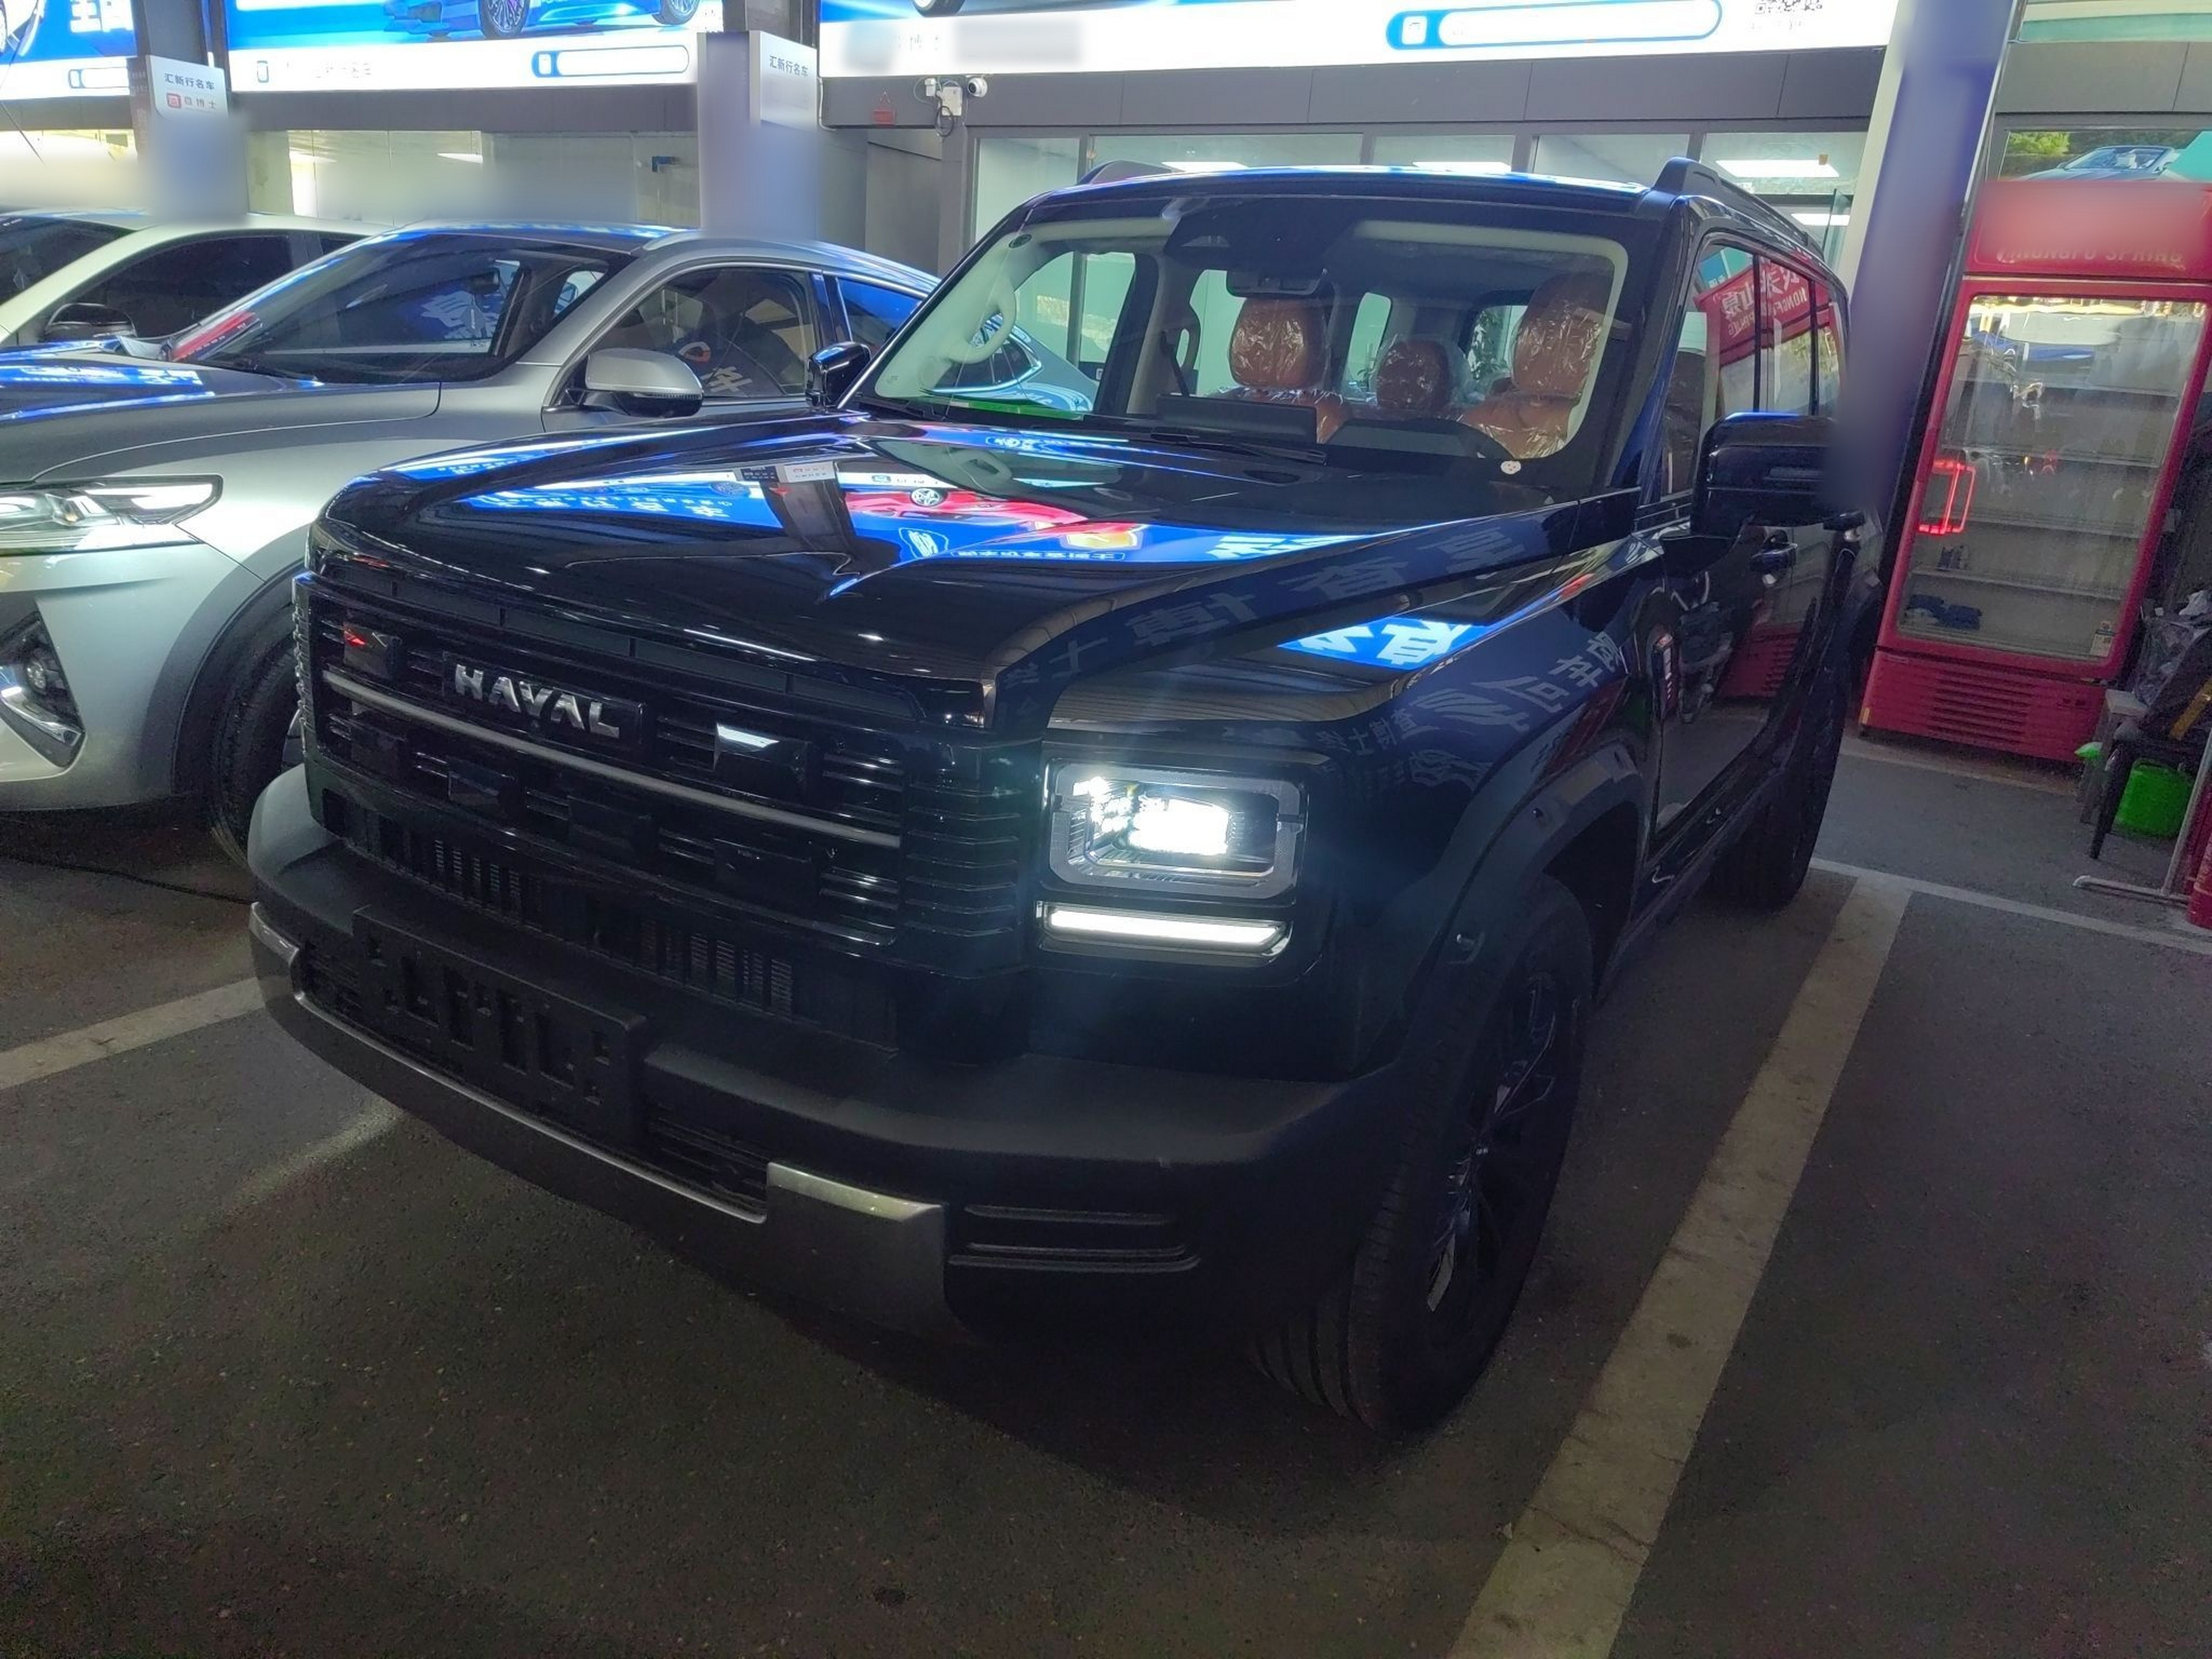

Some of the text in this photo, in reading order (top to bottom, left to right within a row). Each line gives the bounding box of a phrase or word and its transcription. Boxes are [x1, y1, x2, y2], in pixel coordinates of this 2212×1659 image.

[770, 55, 808, 78] 汇新行名车
[165, 73, 215, 90] 汇新行名车
[455, 664, 620, 738] HAVAL
